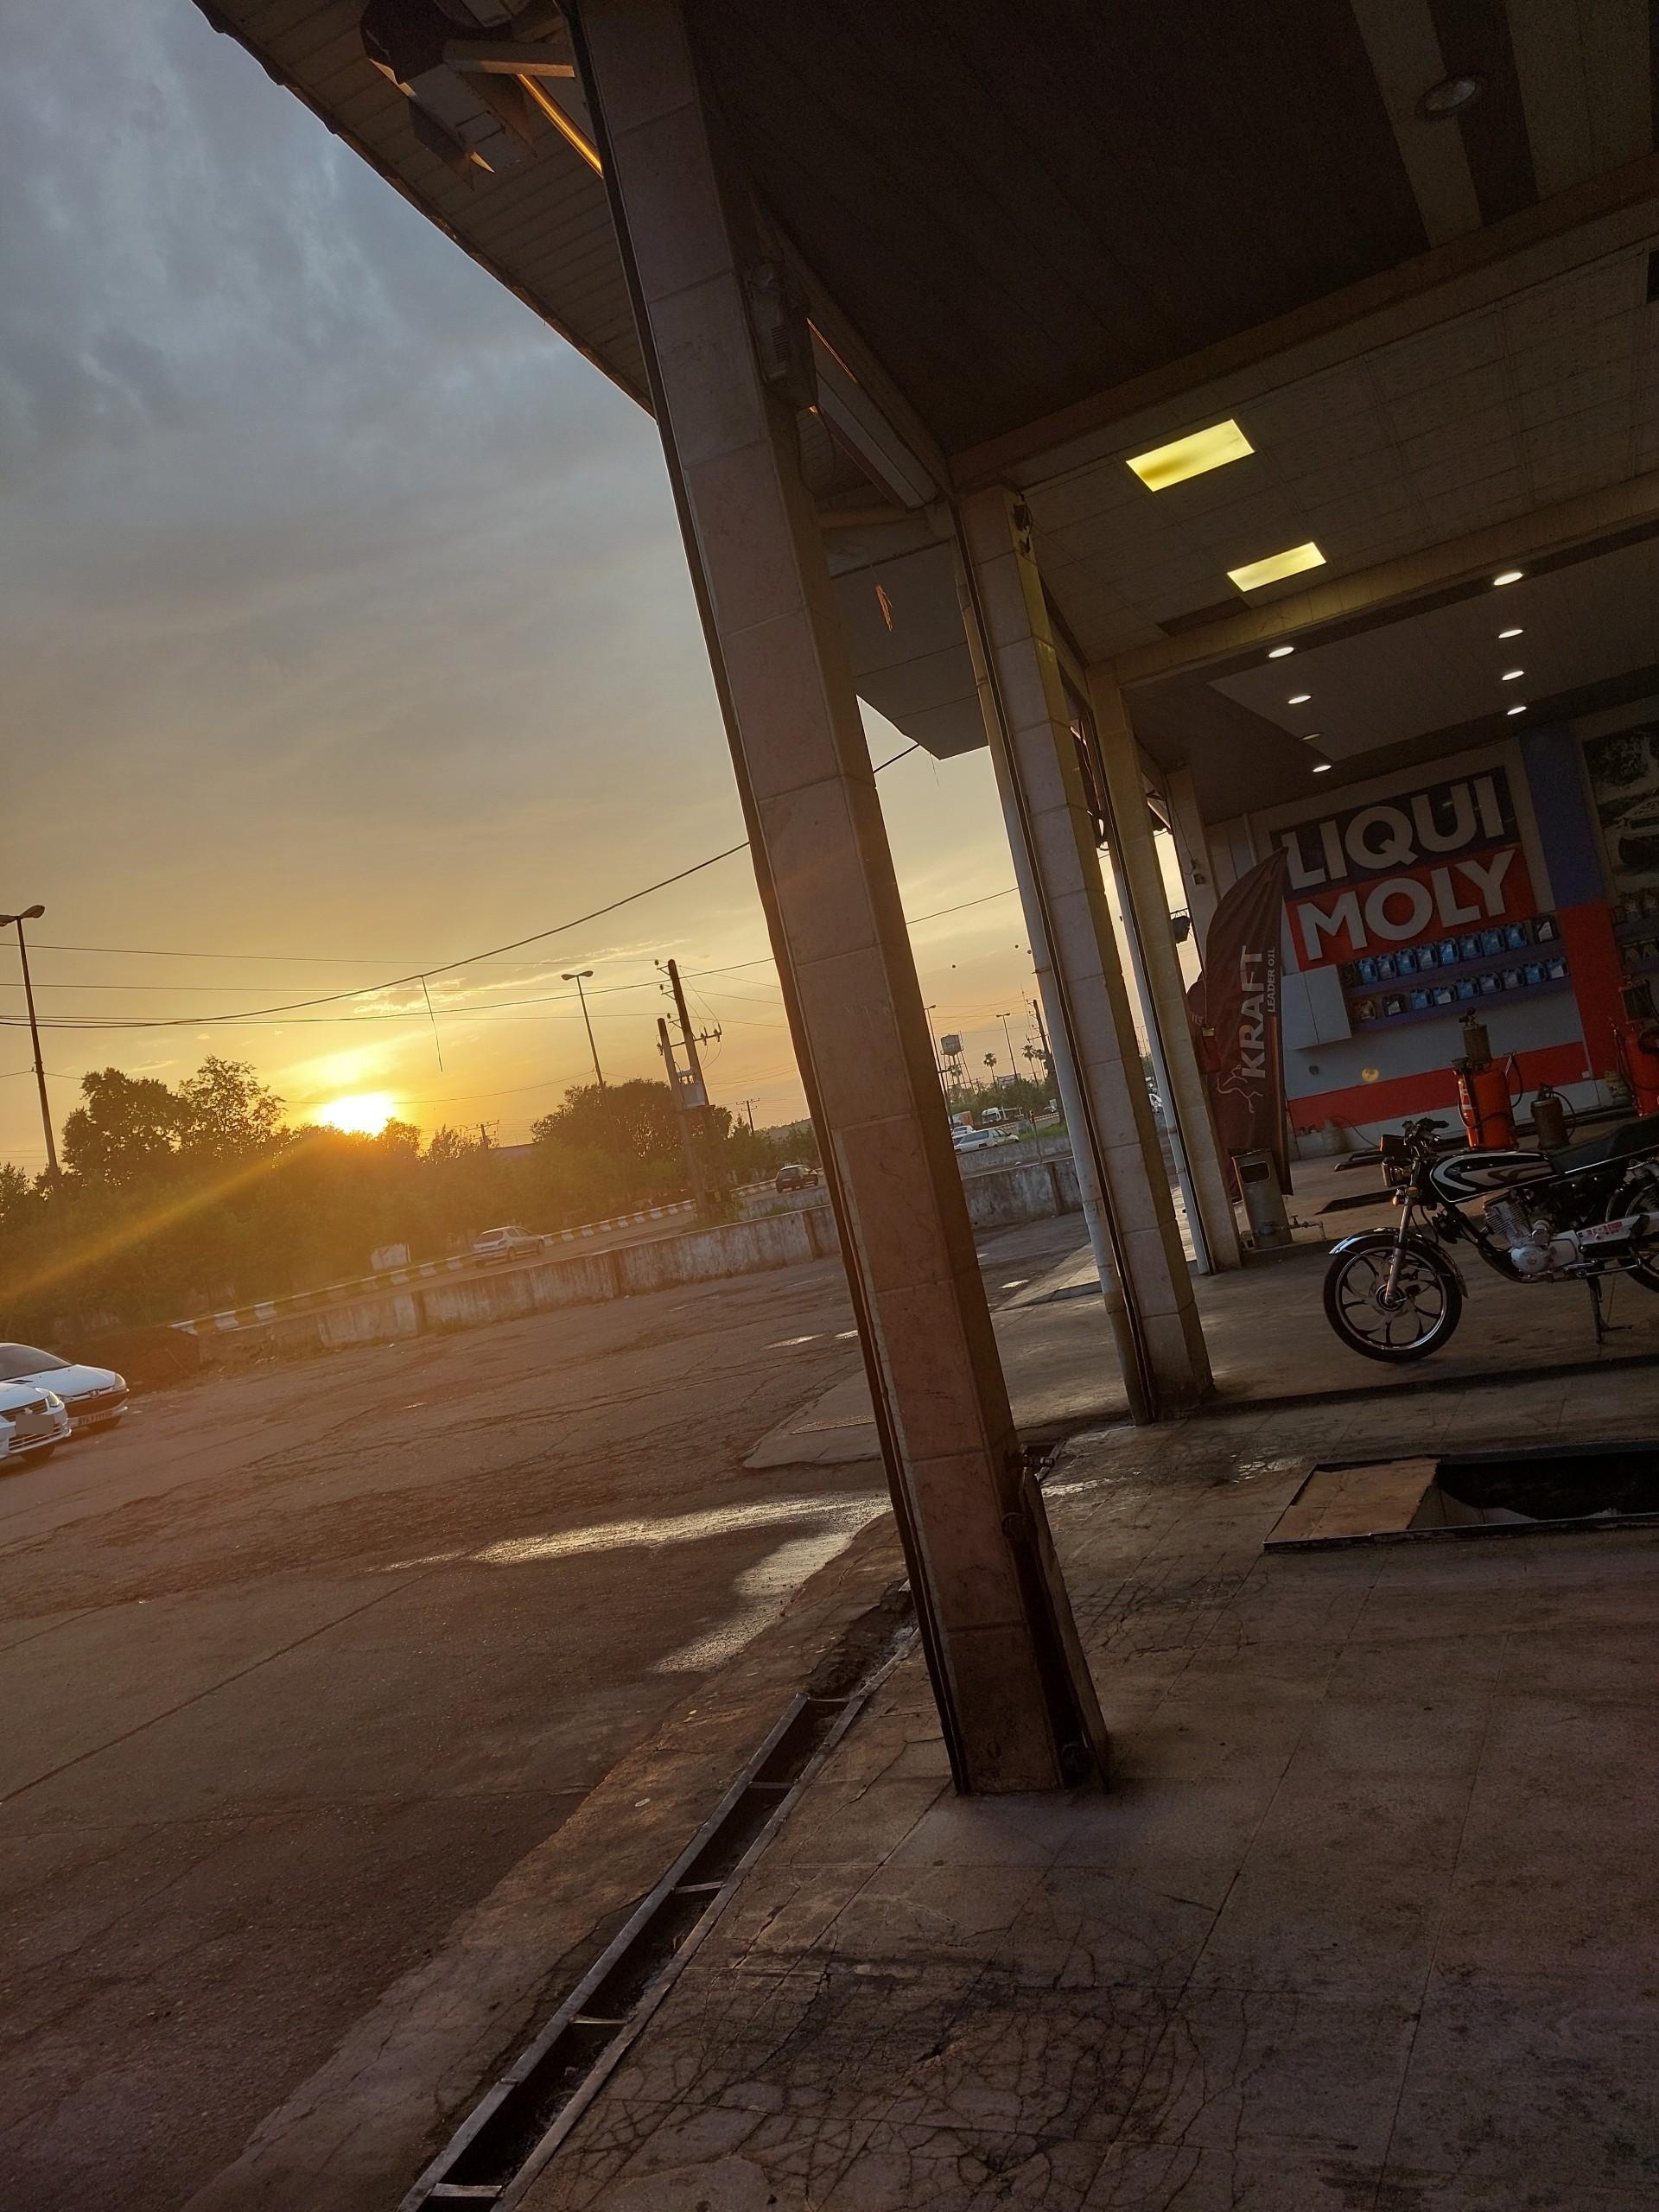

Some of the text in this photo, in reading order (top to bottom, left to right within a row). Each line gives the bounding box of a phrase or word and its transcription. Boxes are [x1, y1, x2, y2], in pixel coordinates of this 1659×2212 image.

[1281, 776, 1506, 890] LIQUI
[1297, 849, 1516, 961] MOLY
[1238, 944, 1266, 1078] KRAFT
[1267, 946, 1276, 1013] LEADER OIL
